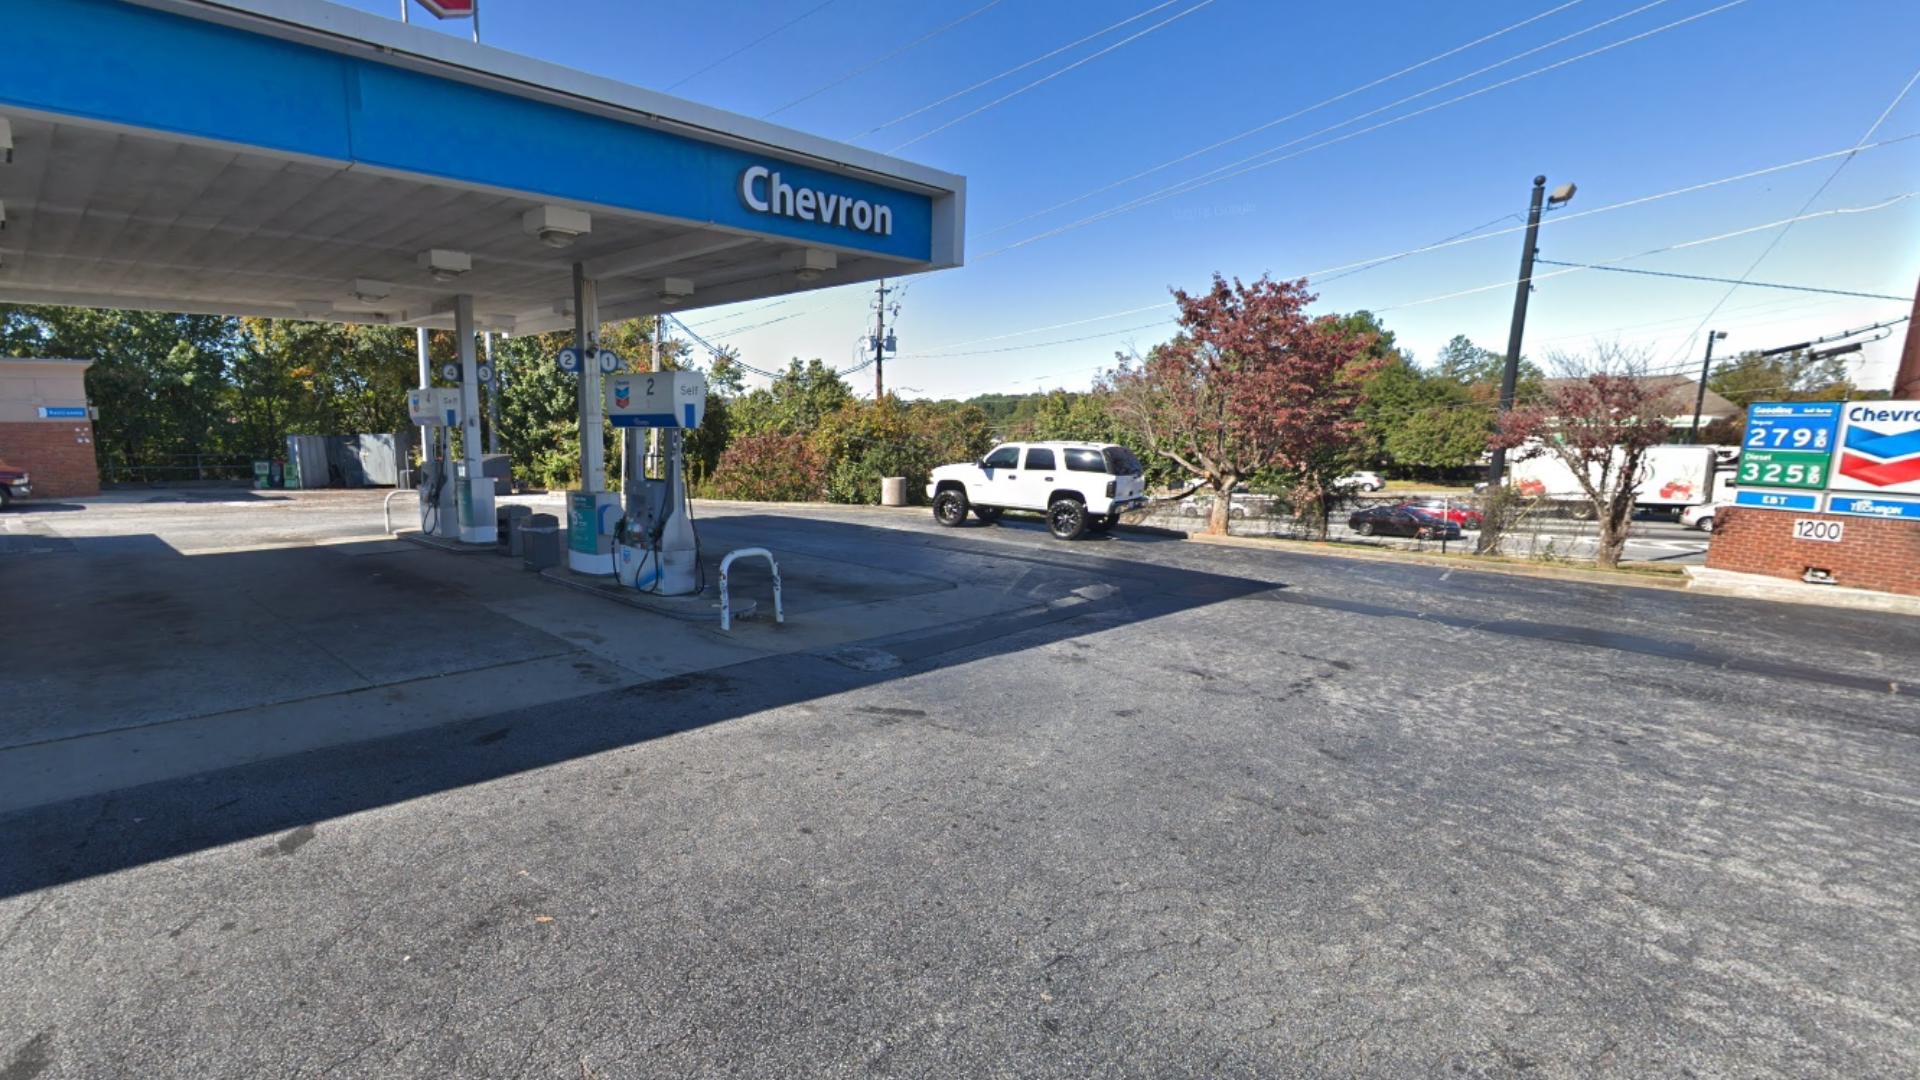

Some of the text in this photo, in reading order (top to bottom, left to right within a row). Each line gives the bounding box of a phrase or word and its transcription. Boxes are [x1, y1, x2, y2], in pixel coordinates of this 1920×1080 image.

[743, 166, 892, 235] Chevron
[647, 378, 655, 395] 2
[680, 385, 699, 395] Self
[1745, 453, 1771, 461] Diesel
[1797, 521, 1840, 540] 1200
